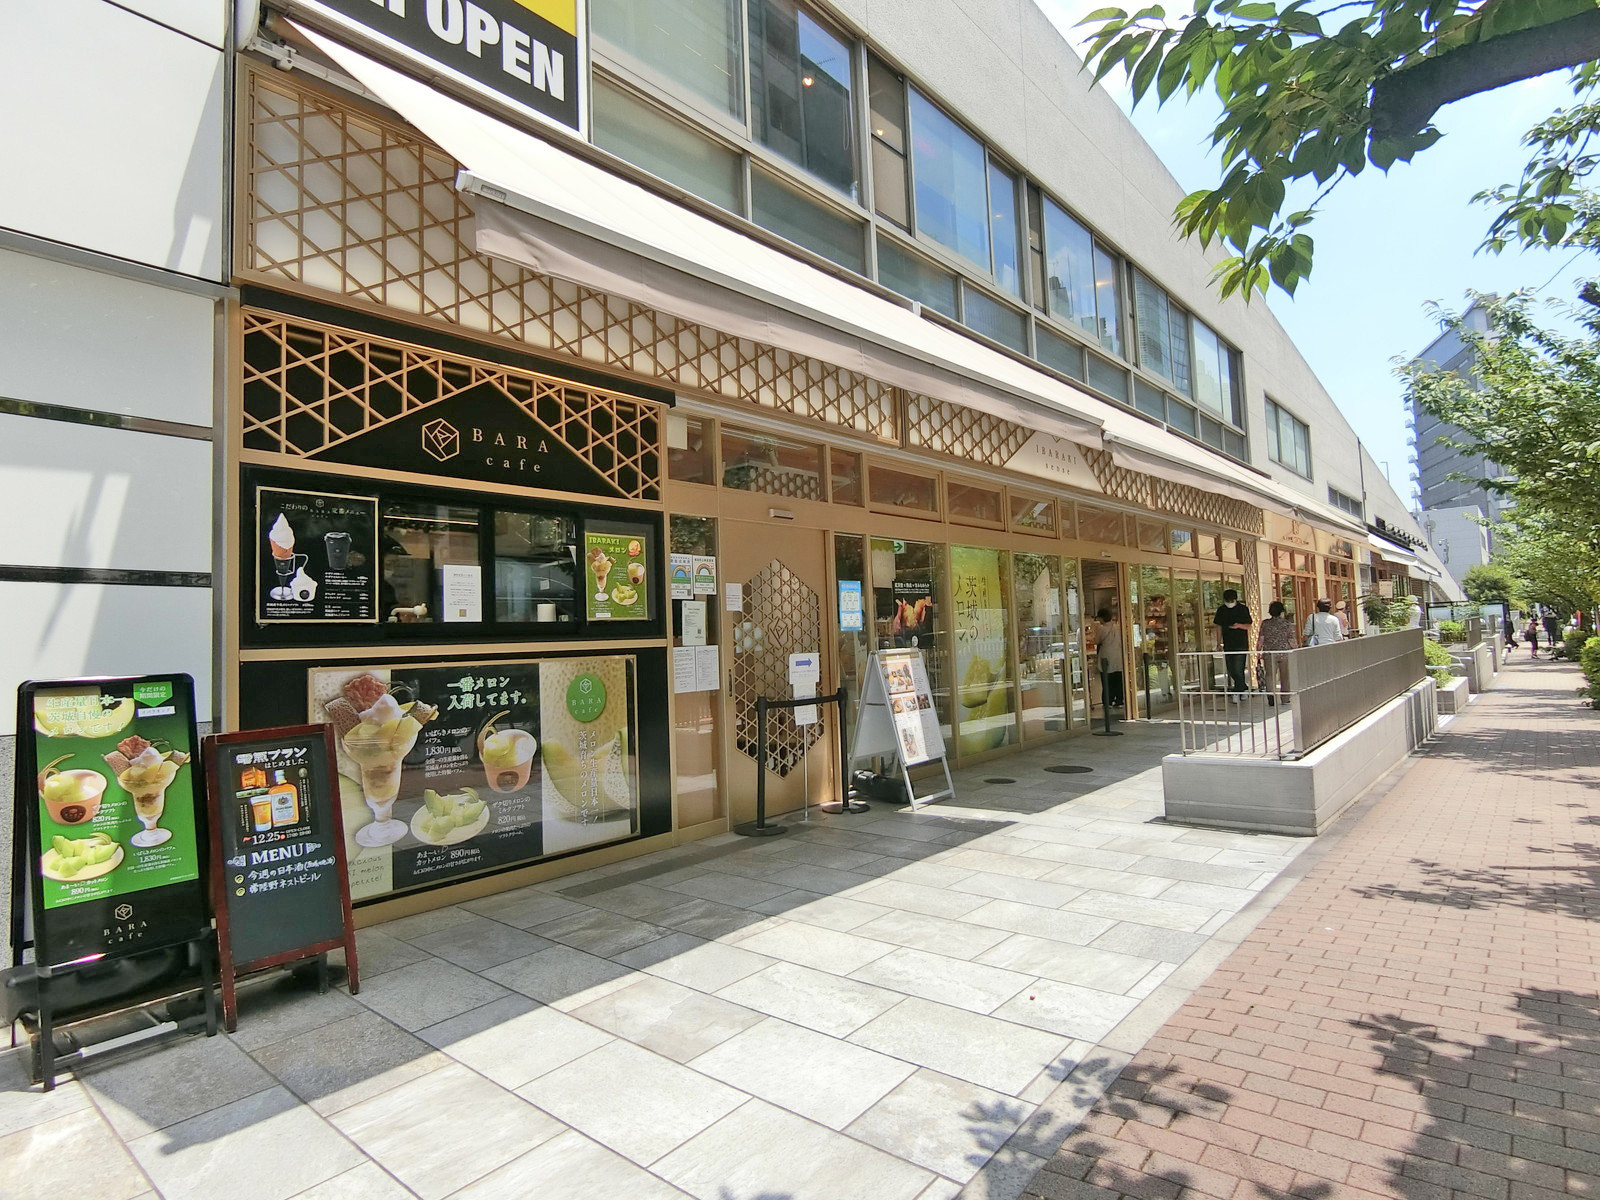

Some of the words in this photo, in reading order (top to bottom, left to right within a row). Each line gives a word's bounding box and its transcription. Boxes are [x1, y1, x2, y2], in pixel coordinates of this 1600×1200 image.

[425, 0, 565, 102] OPEN
[472, 428, 548, 453] BARA
[1036, 444, 1077, 465] IBARAKI
[486, 458, 541, 473] cafe
[589, 536, 620, 546] IBARAKI
[966, 576, 979, 641] 茨城の
[447, 676, 510, 692] 一番メロン
[447, 690, 527, 710] 入荷してます。
[571, 697, 602, 706] BARA
[574, 706, 598, 715] cafe
[264, 759, 309, 769] はじめました。
[251, 843, 304, 865] MENU
[416, 855, 446, 867] カットメロン
[450, 848, 471, 859] 890円
[103, 921, 147, 936] BARA
[108, 932, 143, 945] cafe
